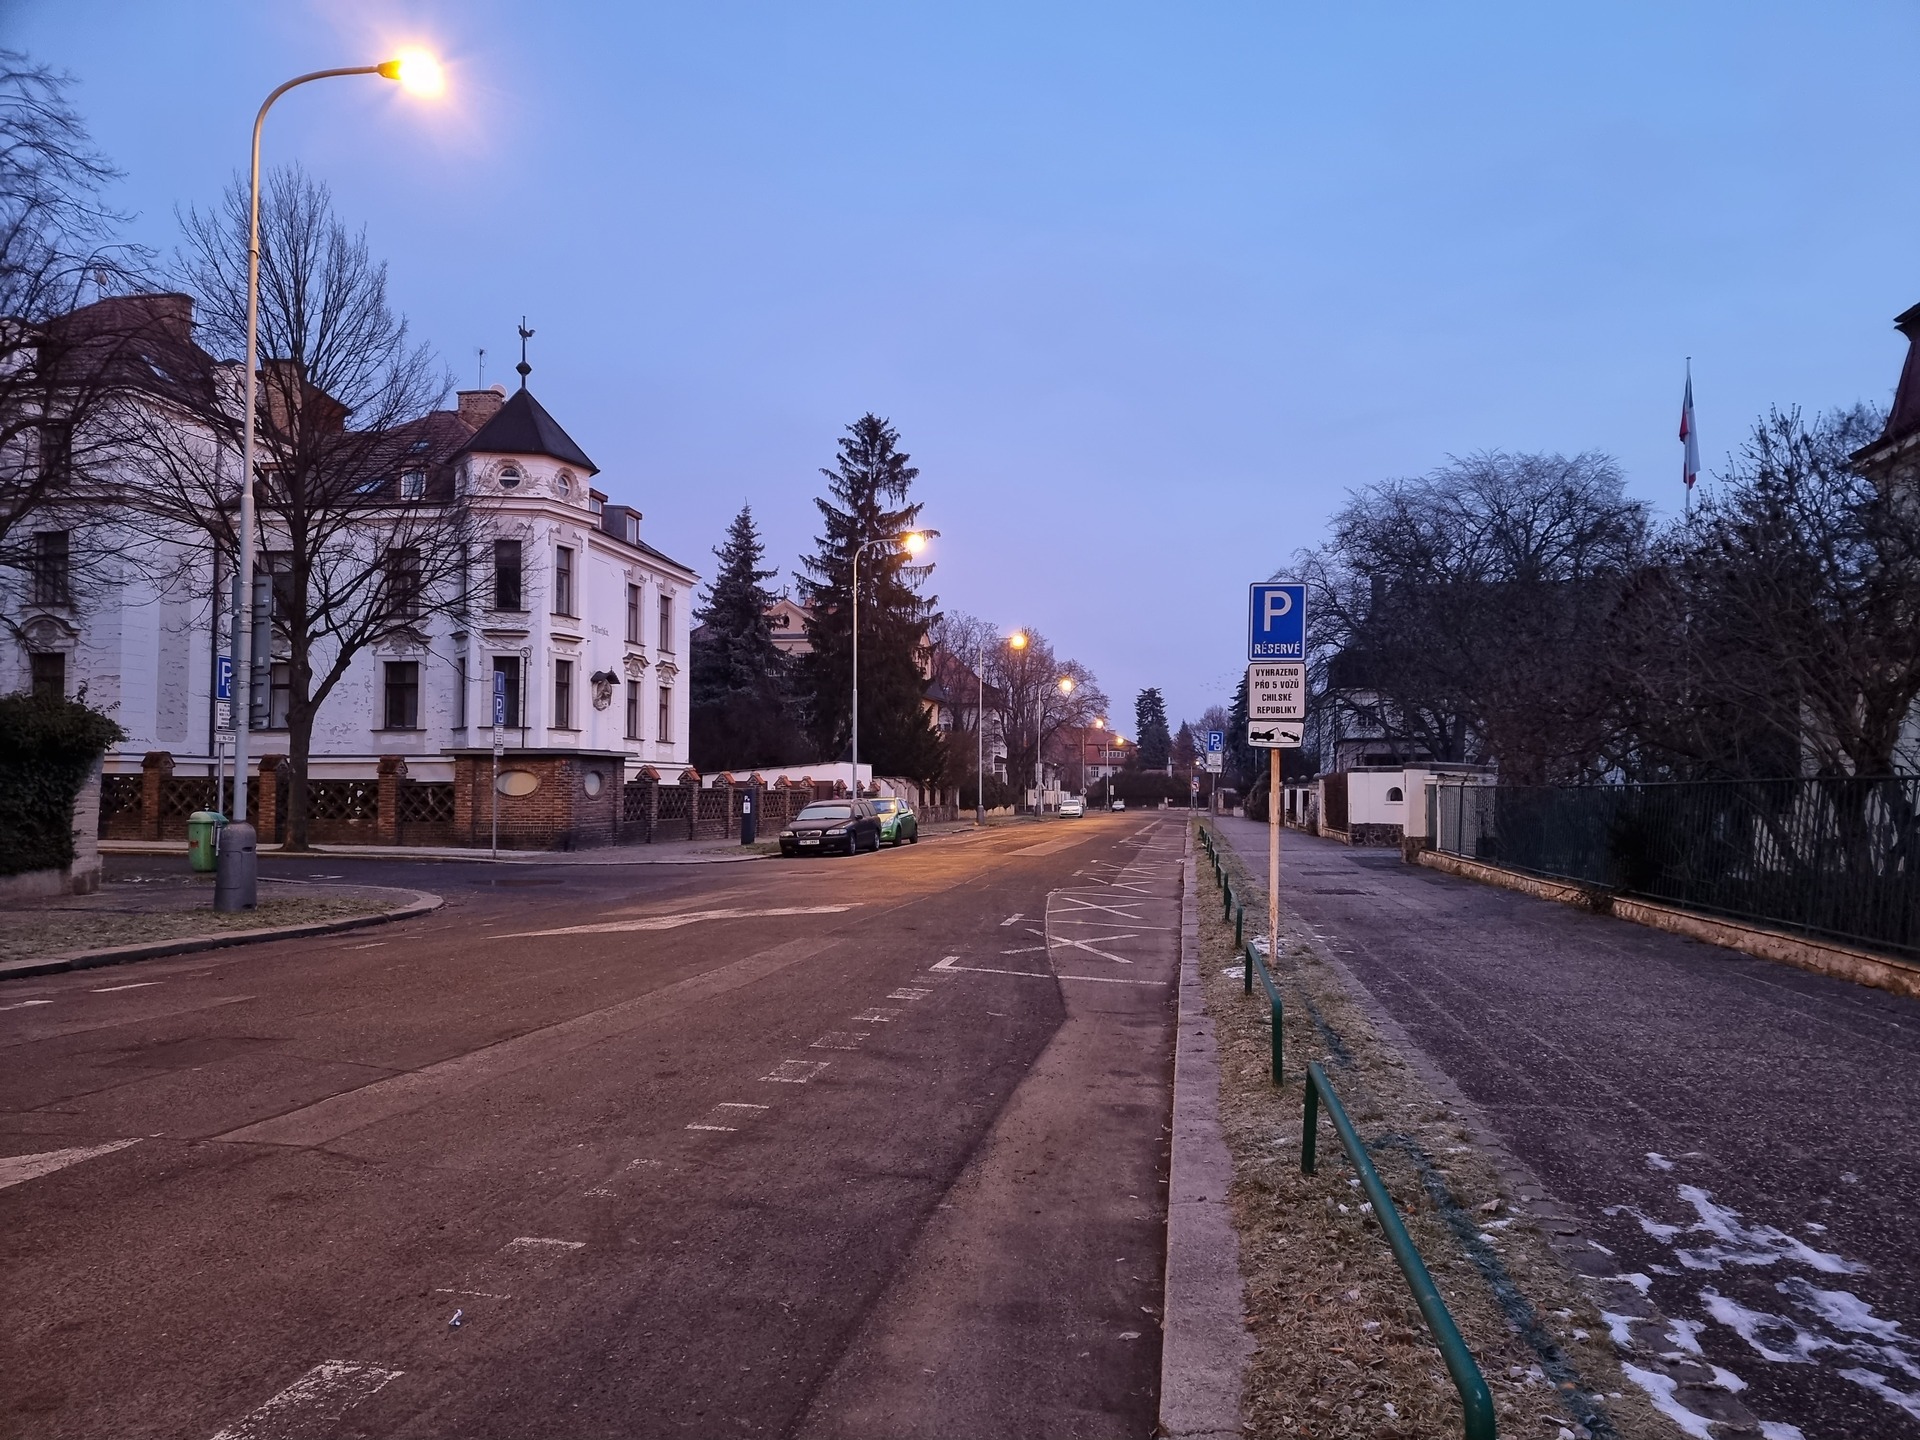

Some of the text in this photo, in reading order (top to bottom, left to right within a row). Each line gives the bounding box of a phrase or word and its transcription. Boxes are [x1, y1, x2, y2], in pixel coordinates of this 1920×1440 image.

[1264, 591, 1292, 631] P
[1254, 641, 1300, 654] RÉSERVÉ
[1255, 668, 1299, 676] VYHRAZENO
[1272, 681, 1278, 689] 5
[1261, 692, 1292, 702] CHILSKÉ
[496, 698, 503, 715] P
[1256, 706, 1297, 714] REPUBLIKY
[1211, 734, 1220, 746] P
